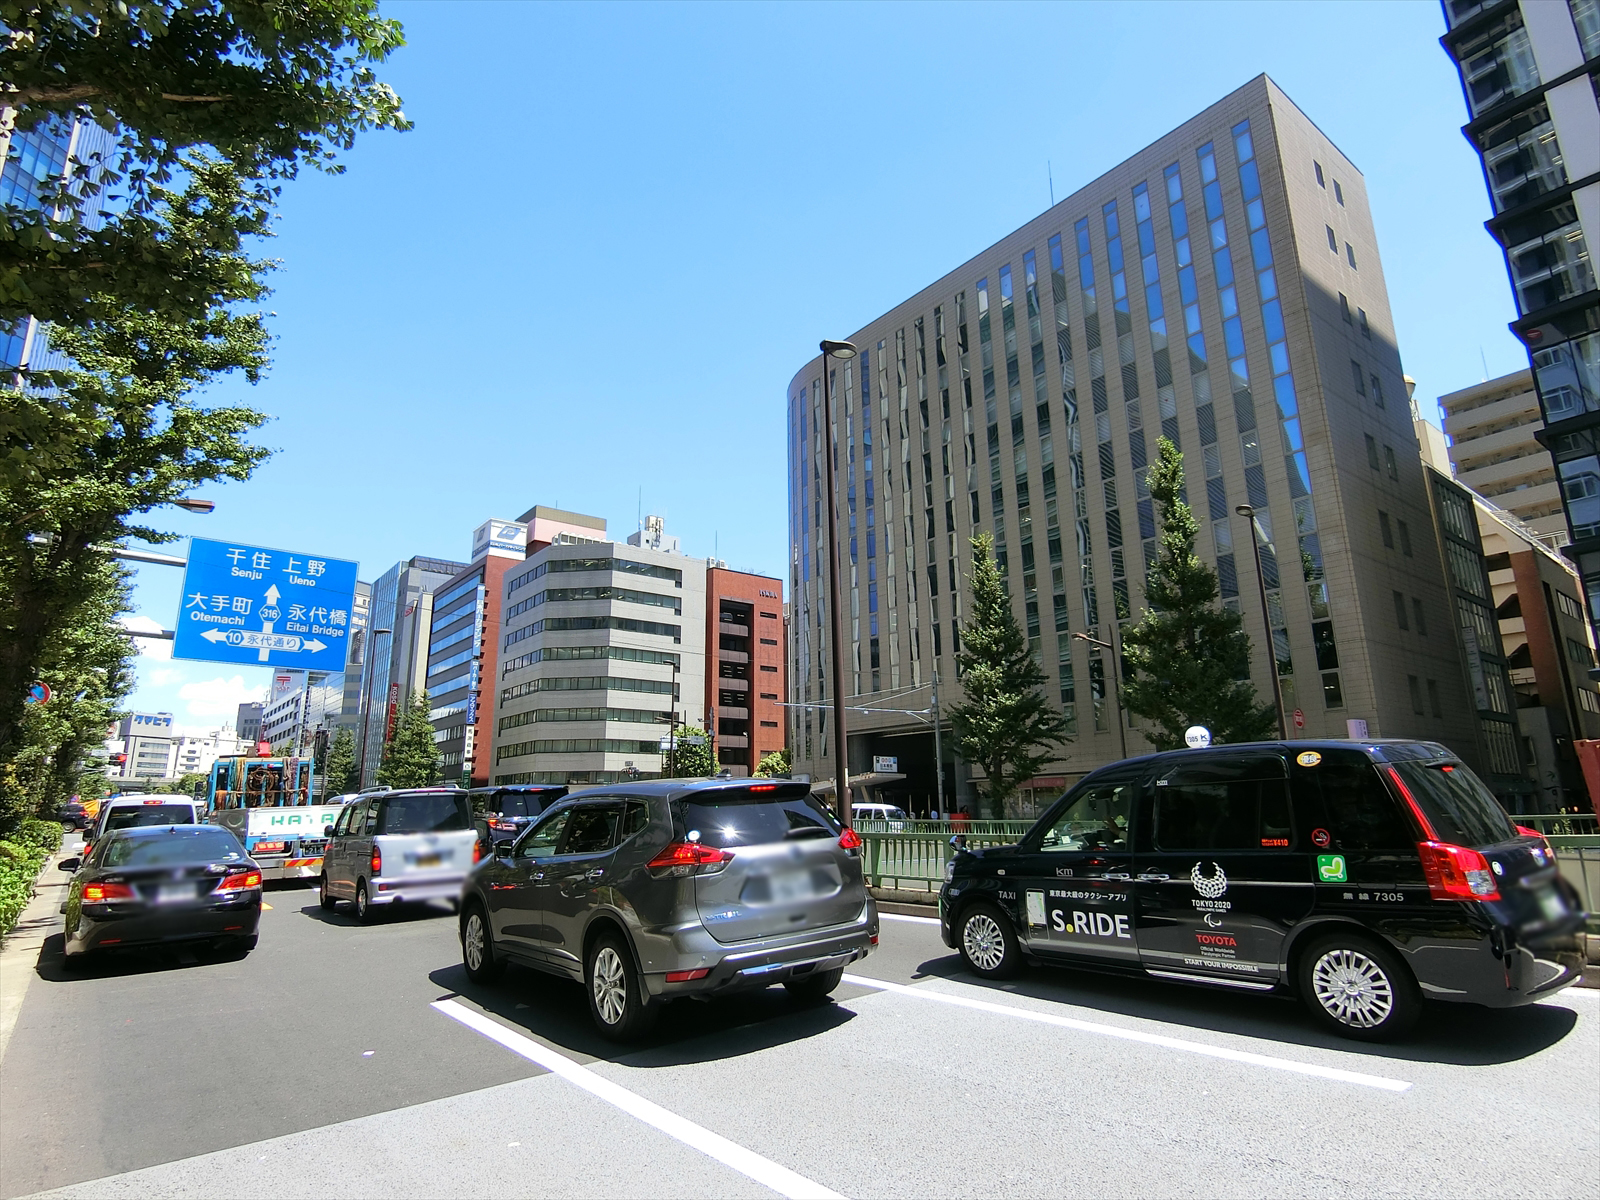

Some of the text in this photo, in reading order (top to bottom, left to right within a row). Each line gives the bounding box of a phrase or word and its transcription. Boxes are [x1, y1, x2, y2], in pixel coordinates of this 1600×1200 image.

[226, 548, 272, 570] 千住
[231, 566, 263, 580] Senju
[282, 556, 326, 578] 上野
[289, 575, 316, 587] Ueno
[186, 592, 253, 615] 大手町
[191, 610, 245, 626] Otemachi
[262, 608, 278, 619] 316
[287, 603, 348, 626] 永代橋
[286, 622, 344, 637] Eitai Bridge
[229, 633, 242, 644] 10
[247, 634, 297, 648] 永代通り
[134, 715, 171, 727] クマヒラ
[1055, 867, 1073, 876] km
[998, 891, 1016, 900] TAXI
[1049, 889, 1127, 902] 東京最大級のタクシーアプリ
[1373, 892, 1404, 902] 7305
[1191, 899, 1231, 909] TOKYO 2020
[1051, 909, 1131, 938] S.RIDE
[1195, 934, 1237, 946] TOYOTA
[1184, 958, 1259, 972] START YOUR IMPOSSIBLE
